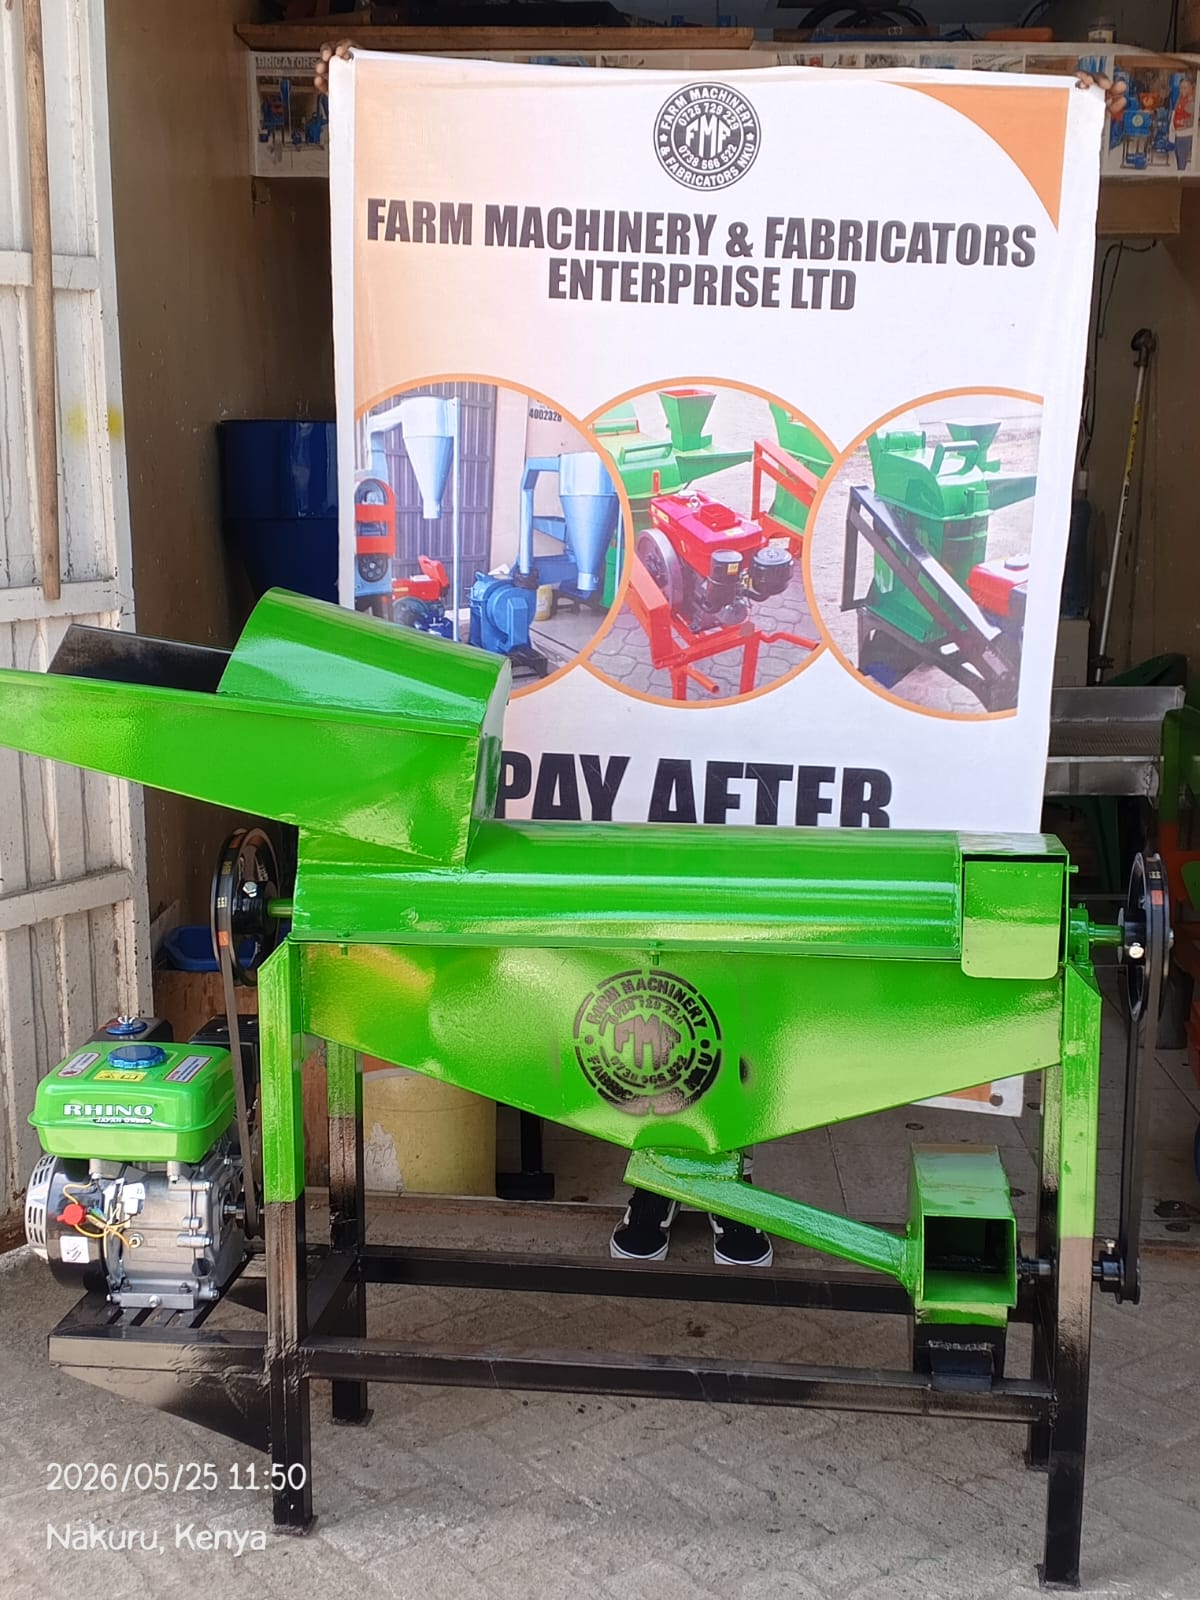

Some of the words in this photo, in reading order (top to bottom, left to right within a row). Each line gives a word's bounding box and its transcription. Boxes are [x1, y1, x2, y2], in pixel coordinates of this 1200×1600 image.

[256, 56, 317, 69] BRICATORS
[660, 95, 688, 130] FARM
[689, 87, 755, 128] MACHINERY
[678, 104, 702, 127] 0725
[665, 156, 740, 187] FABRICATORS
[737, 143, 755, 168] NKU
[367, 198, 473, 246] FARM
[485, 203, 717, 256] MACHINERY
[726, 221, 753, 258] &
[764, 216, 1037, 268] FABRICATORS
[548, 257, 781, 309] ENTERPRISE
[791, 267, 857, 311] LTD
[494, 750, 632, 822] PAY
[647, 757, 893, 829] AFTER
[63, 1104, 153, 1117] RHINO
